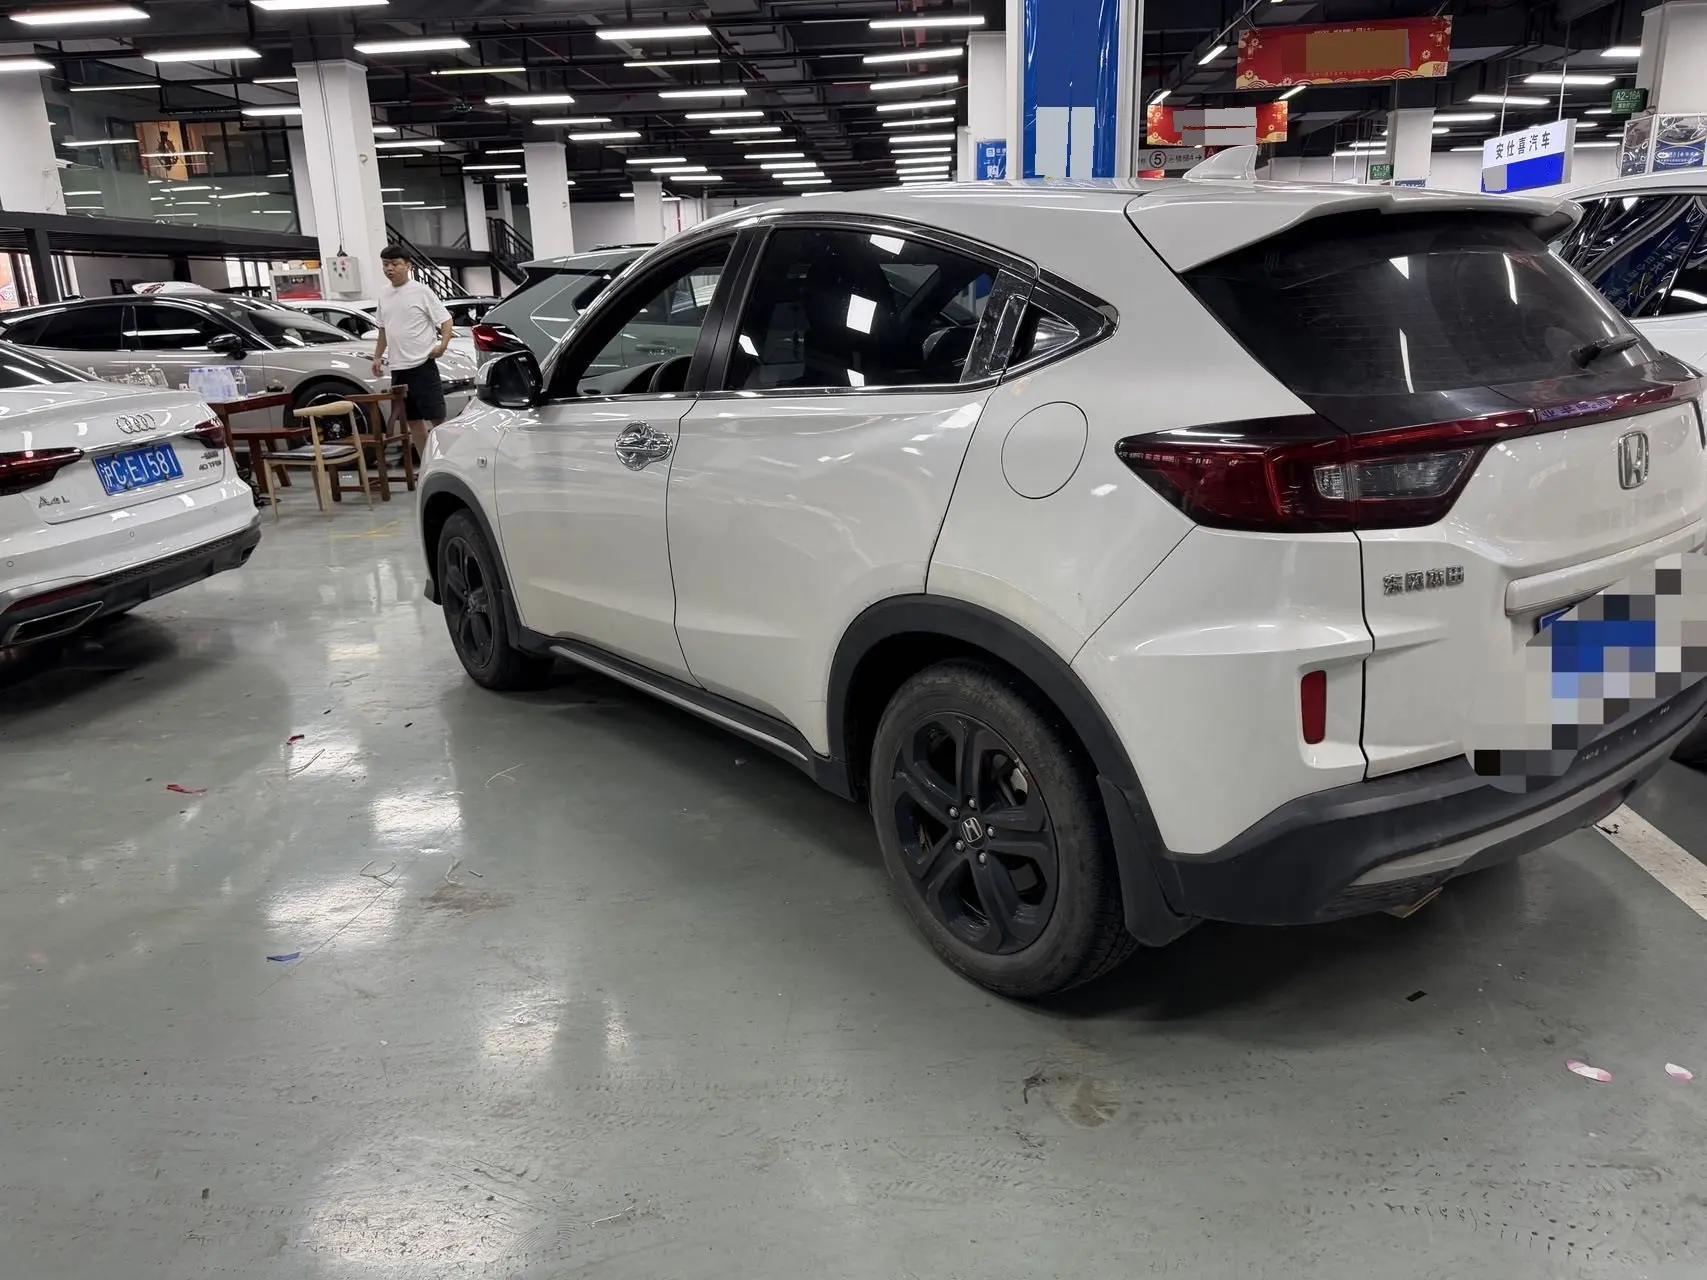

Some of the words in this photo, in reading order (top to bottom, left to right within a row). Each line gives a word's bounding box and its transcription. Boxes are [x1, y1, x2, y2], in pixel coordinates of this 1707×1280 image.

[1495, 131, 1551, 160] 安仕喜汽车
